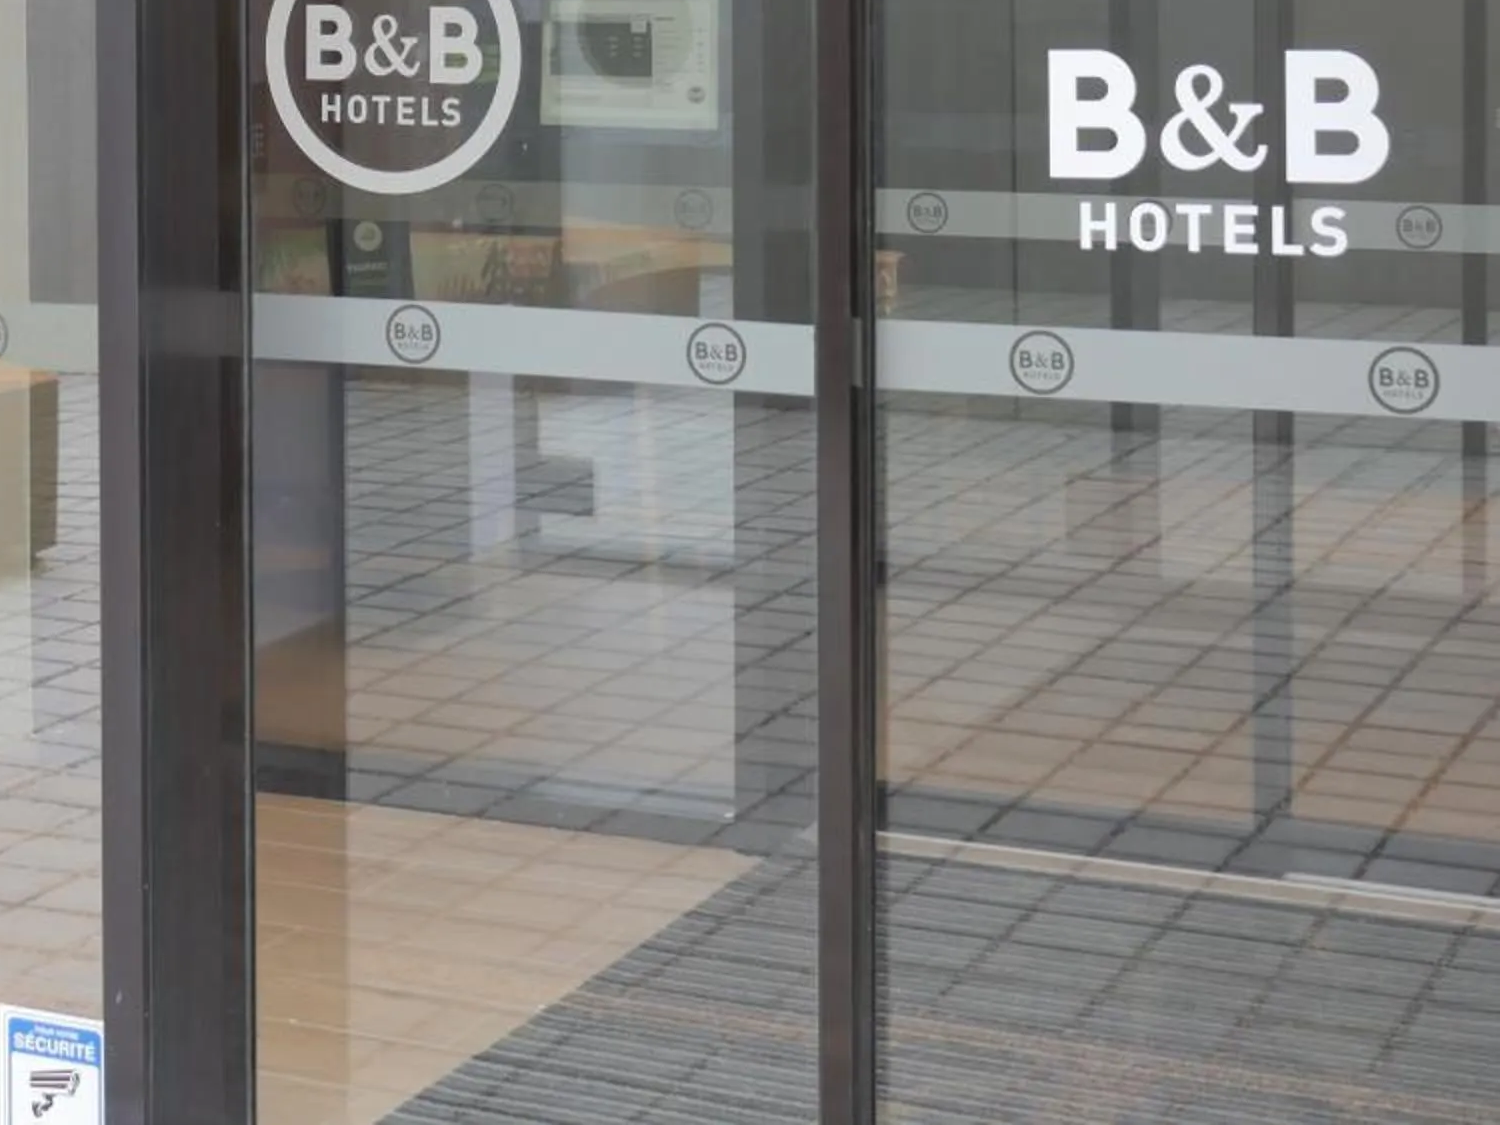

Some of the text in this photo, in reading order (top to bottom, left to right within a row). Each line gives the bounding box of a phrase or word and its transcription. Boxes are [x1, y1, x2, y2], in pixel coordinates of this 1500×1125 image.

[305, 4, 484, 85] B&B
[320, 93, 462, 127] HOTELS
[1047, 48, 1391, 184] B&B
[1078, 201, 1349, 258] HOTELS
[394, 322, 434, 341] B&B
[695, 341, 738, 362] B&B
[1019, 350, 1065, 370] B&B
[1379, 366, 1430, 388] B&B
[12, 1029, 97, 1063] SÉCURITÉ
